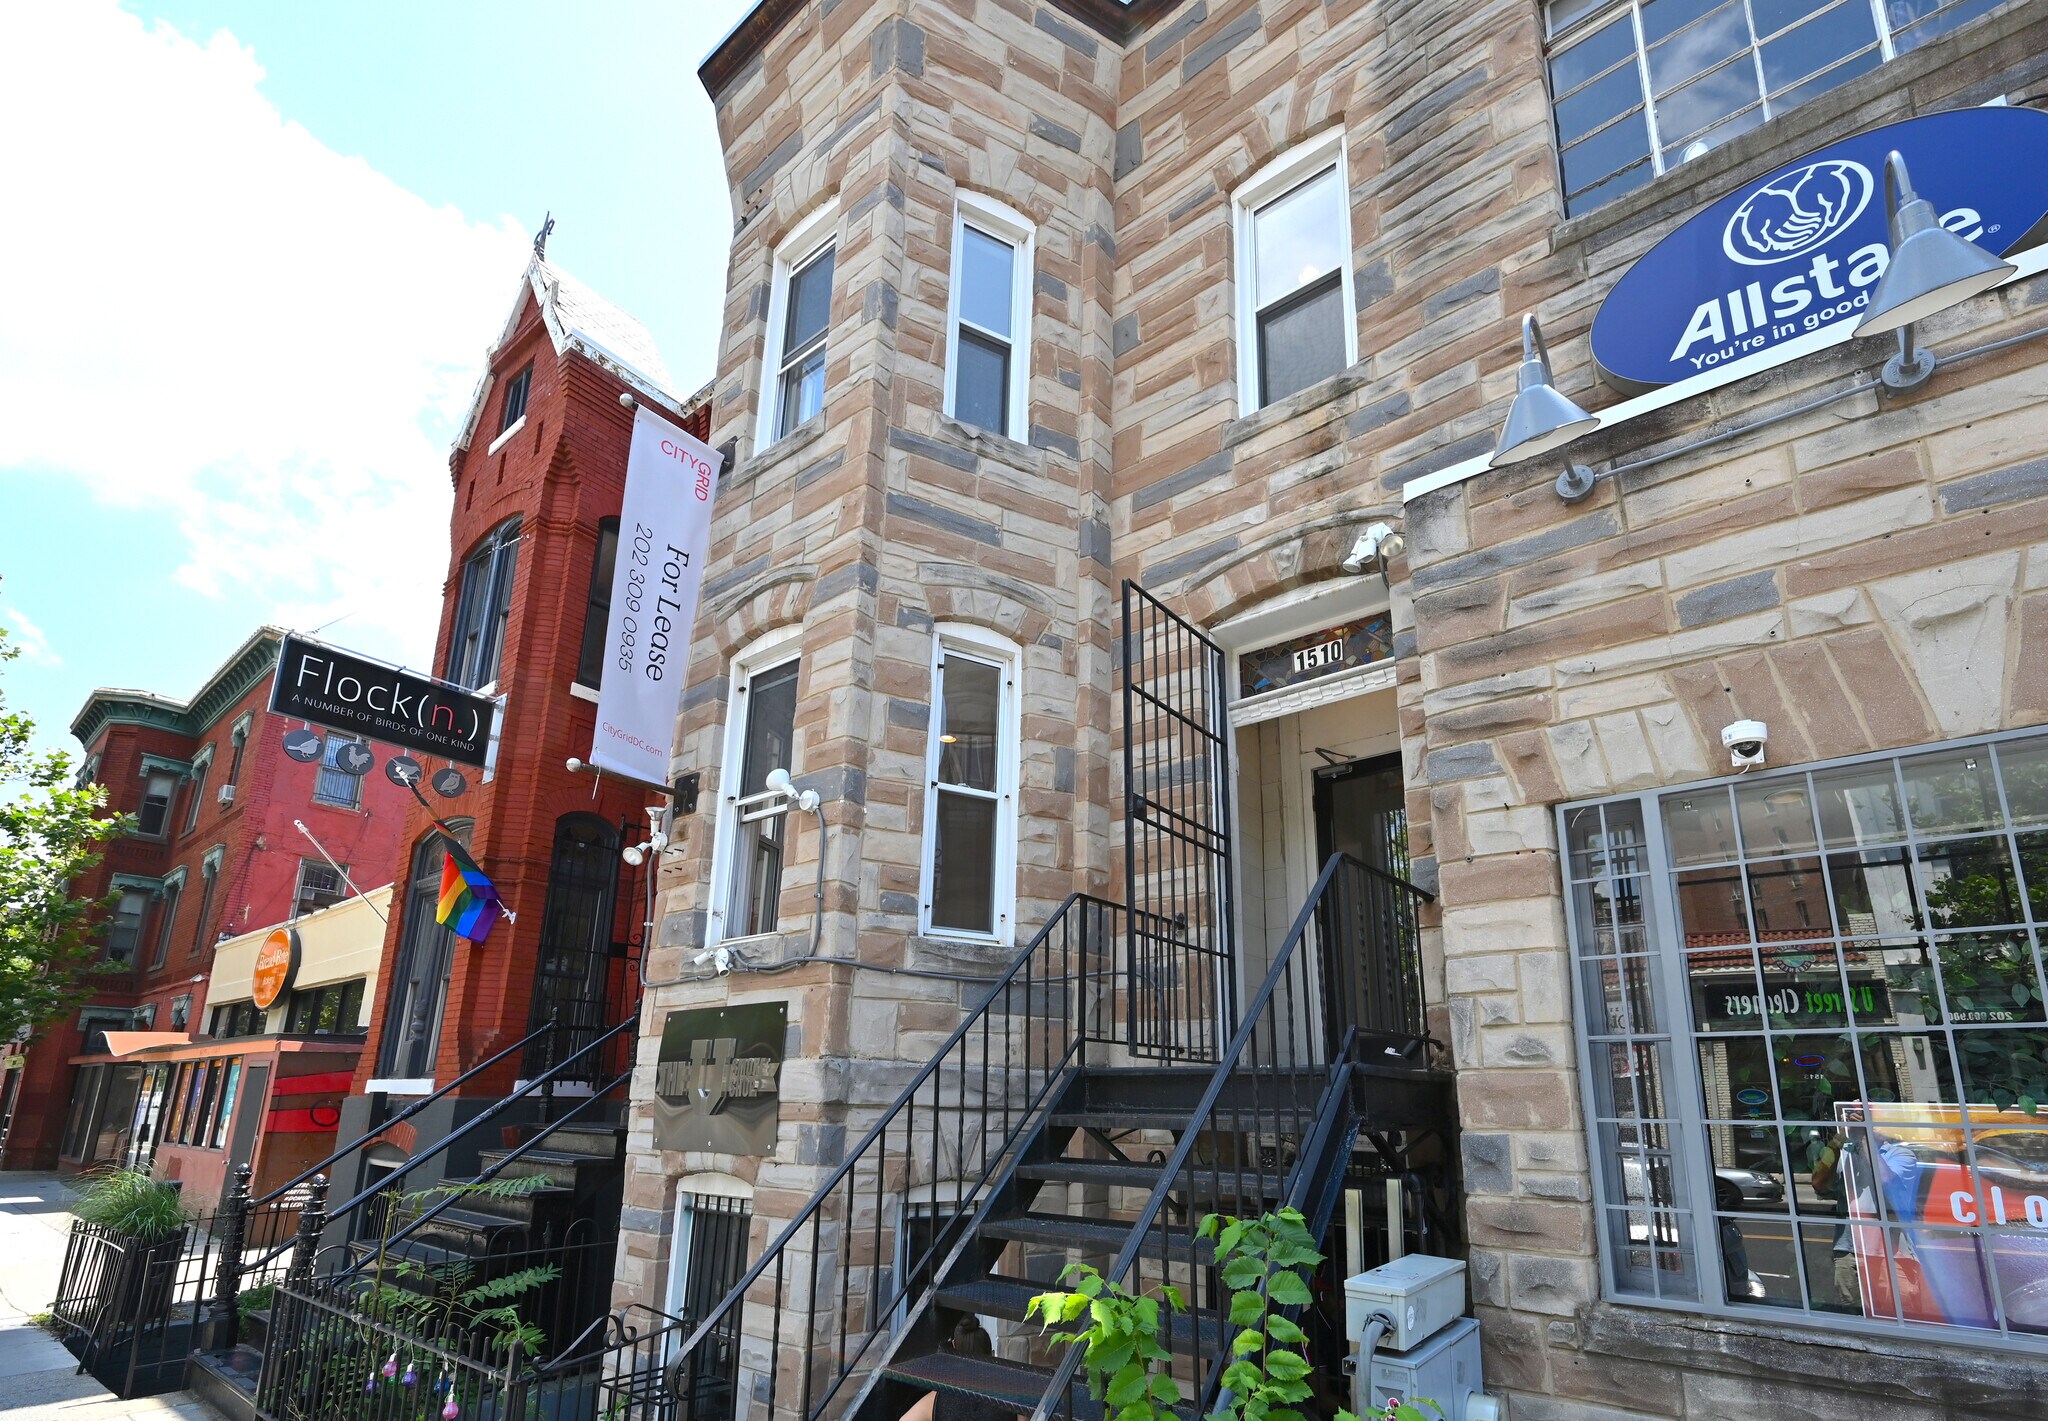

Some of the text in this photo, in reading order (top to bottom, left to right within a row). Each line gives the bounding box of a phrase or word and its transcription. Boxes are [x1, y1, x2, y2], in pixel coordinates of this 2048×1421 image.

[1669, 207, 1984, 362] Allstae
[1690, 290, 1870, 370] You're in good
[618, 522, 653, 674] 202 309 0935
[646, 543, 690, 682] For Lease
[1296, 641, 1342, 671] 1510
[292, 693, 475, 752] A NUMBER OF BIRDS OF ONE KIND
[602, 721, 663, 757] CityGridDC.com
[731, 1058, 771, 1077] SMOKE
